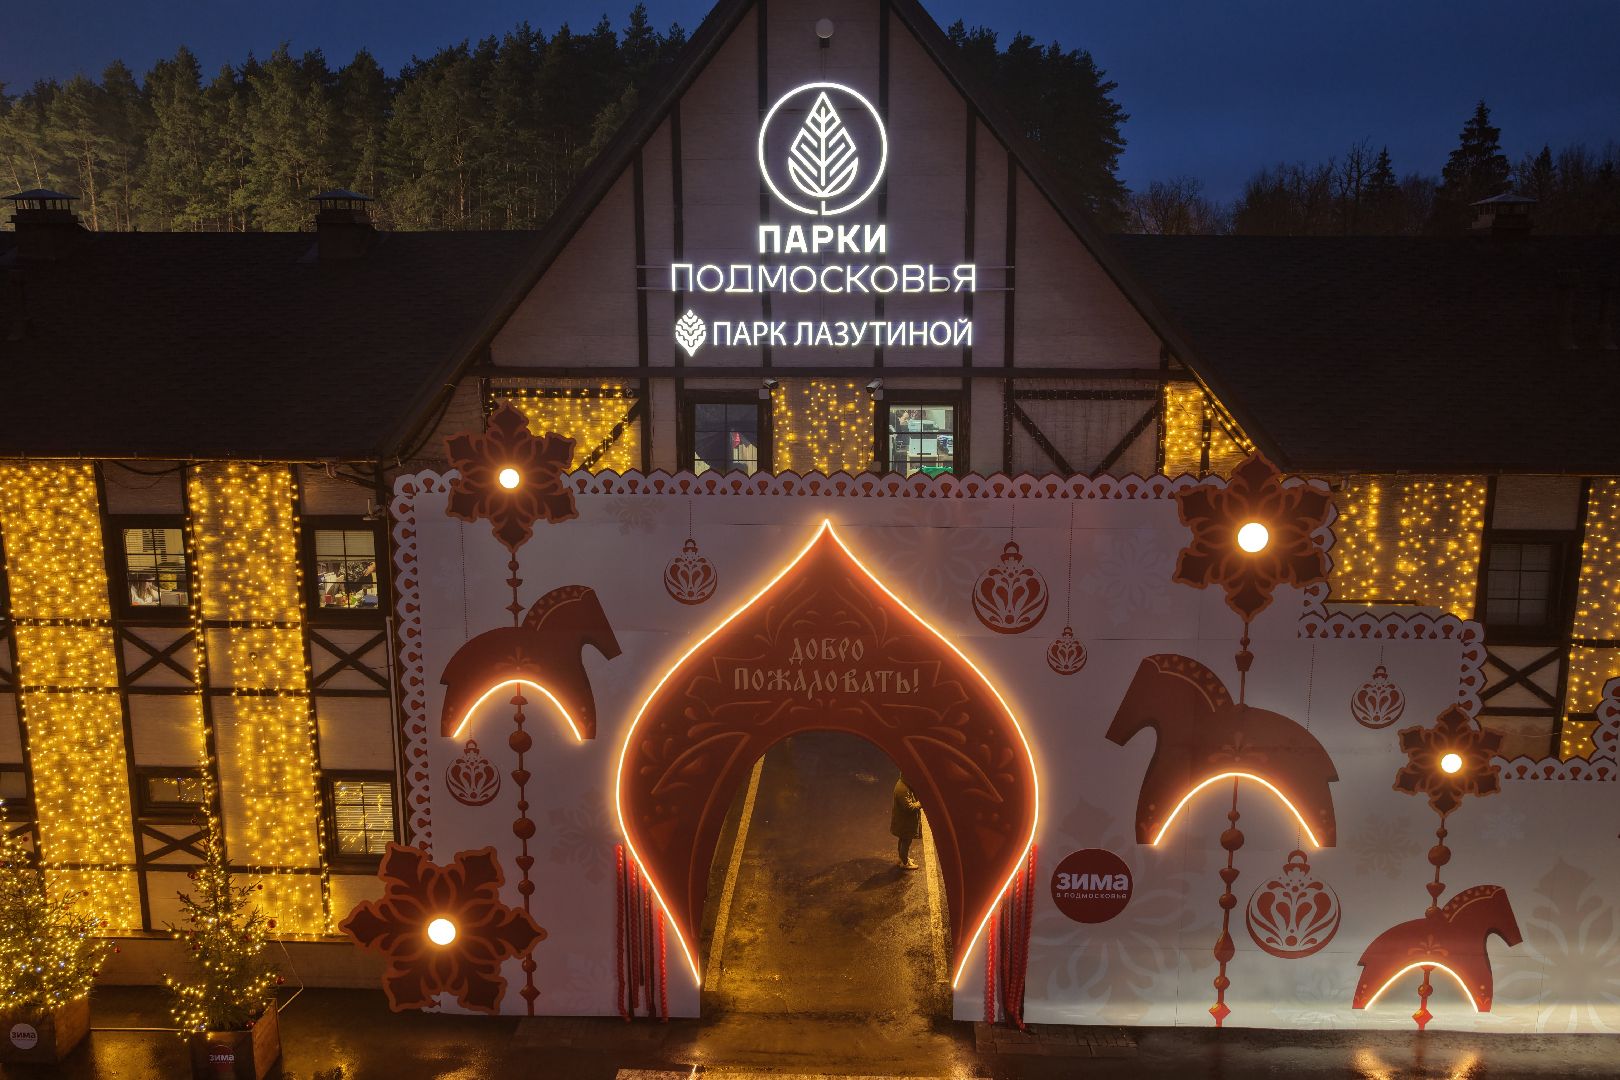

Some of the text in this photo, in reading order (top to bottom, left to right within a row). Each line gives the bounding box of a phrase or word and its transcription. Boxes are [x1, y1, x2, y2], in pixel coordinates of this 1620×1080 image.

[758, 224, 886, 254] ПАРКИ
[671, 263, 977, 293] ПОДМОСКОВЬЯ
[712, 318, 973, 346] ПАРК ЛАЗУТИНОЙ
[788, 637, 864, 665] ДОБРО
[734, 667, 919, 700] ПОЖАЛОВАТЬ!
